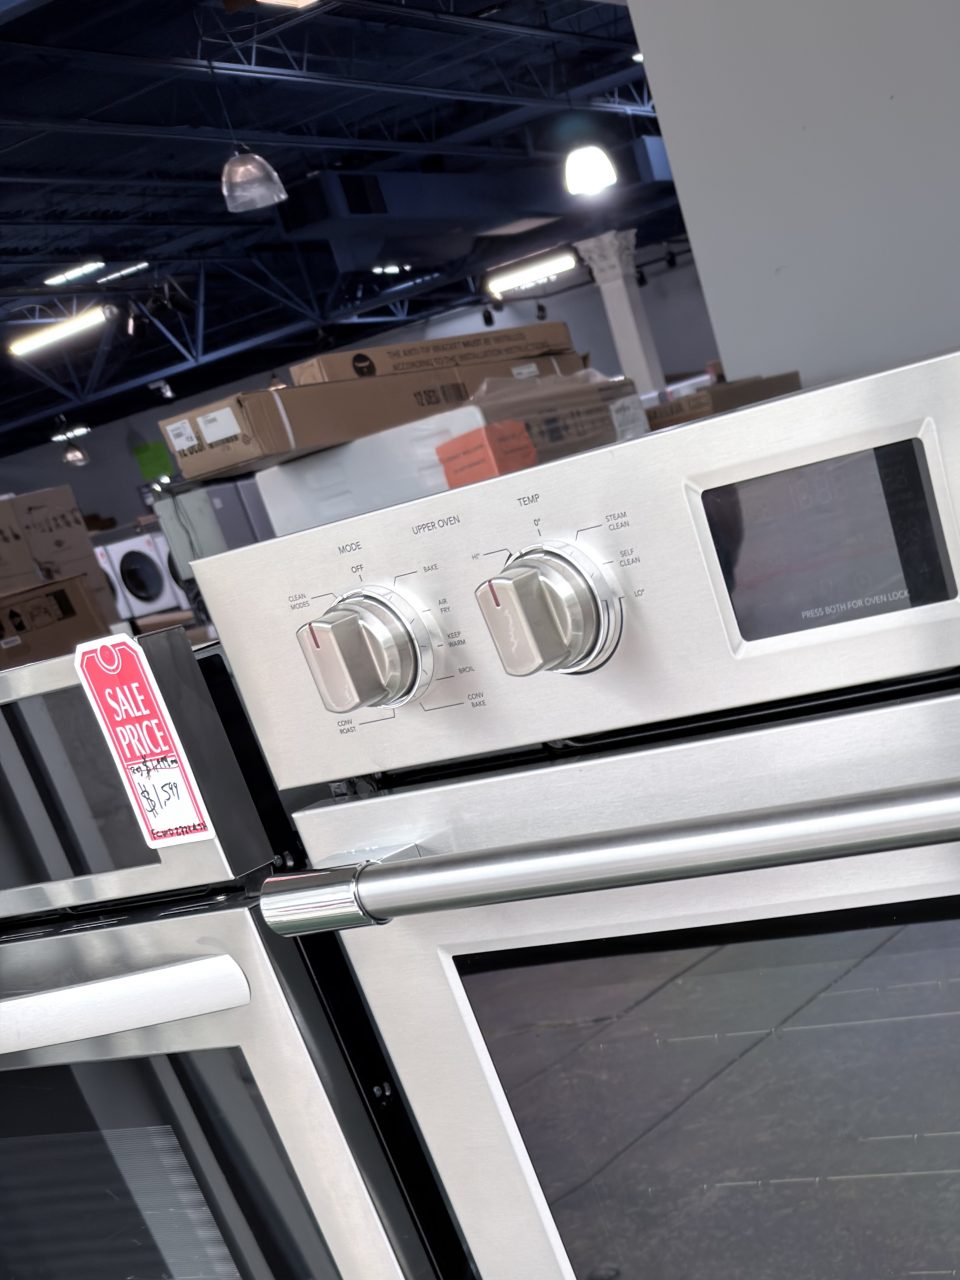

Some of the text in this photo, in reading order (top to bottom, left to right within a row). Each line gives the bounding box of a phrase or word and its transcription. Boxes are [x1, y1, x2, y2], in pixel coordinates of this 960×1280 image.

[517, 493, 540, 508] TEMP
[605, 511, 627, 523] STEAM
[412, 515, 460, 536] UPPER OVEN
[608, 519, 630, 532] CLEAN
[338, 540, 362, 555] MODE
[619, 548, 635, 558] SELF
[619, 555, 641, 568] CLEAN
[351, 563, 364, 575] OFF
[423, 563, 439, 573] BAKE
[288, 592, 307, 603] CLEAN
[438, 598, 448, 607] AIR
[289, 601, 310, 612] MODES
[802, 589, 910, 619] PRESS BOTH FOR OVEN LOCK
[440, 605, 451, 615] FRY
[447, 630, 462, 640] KEEP
[448, 637, 466, 649] WARM
[458, 665, 475, 675] BROIL
[105, 682, 150, 721] SALE
[467, 691, 485, 701] CONV
[470, 699, 487, 709] BAKE
[337, 718, 353, 728] CONV
[339, 726, 357, 735] ROAST
[116, 719, 170, 758] PRICE
[138, 782, 179, 818] $1,599
